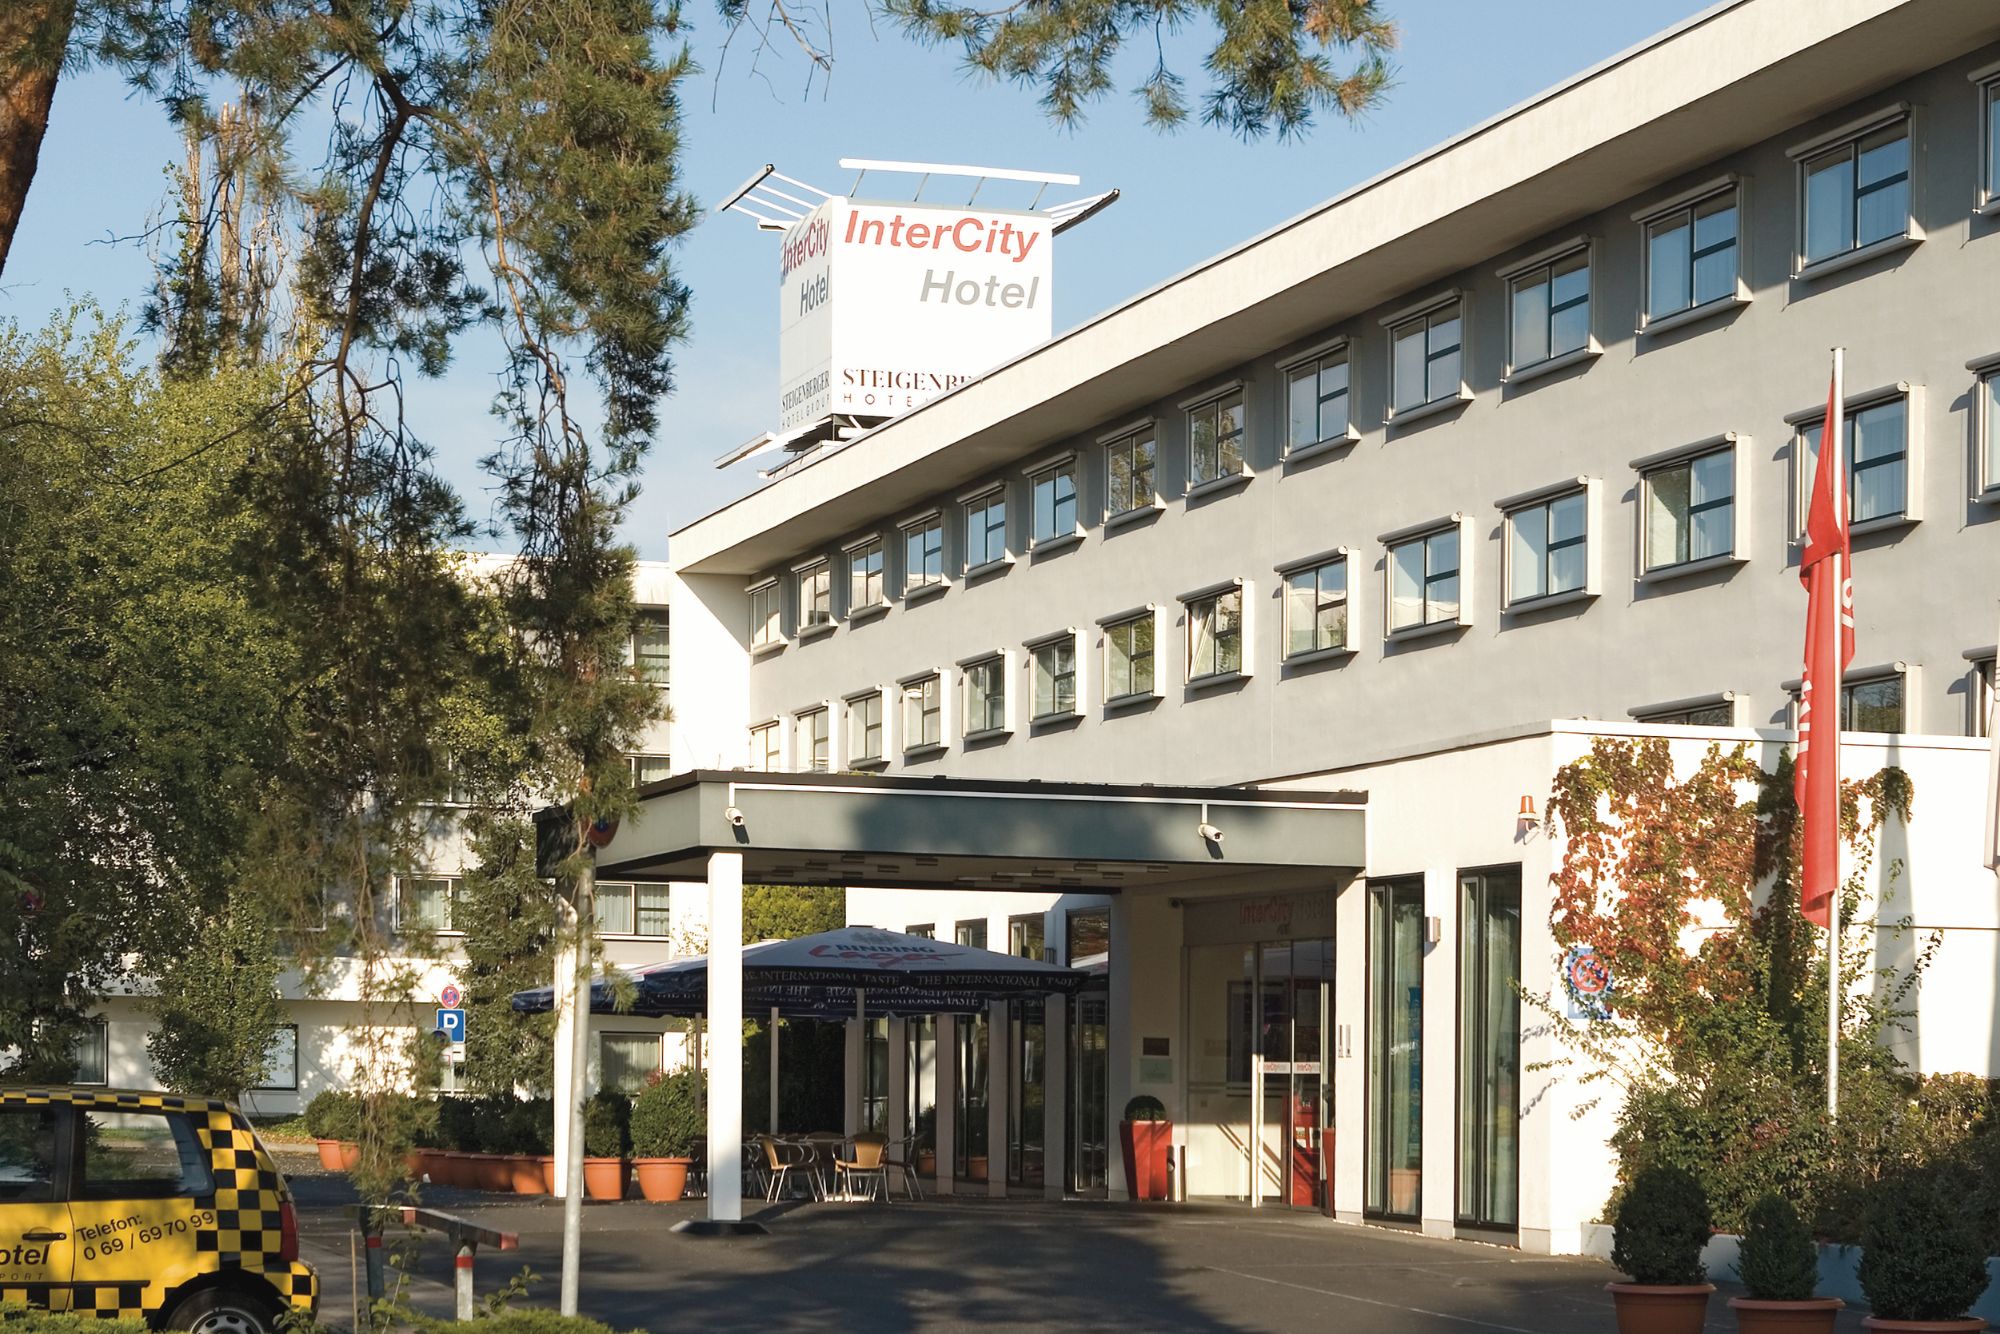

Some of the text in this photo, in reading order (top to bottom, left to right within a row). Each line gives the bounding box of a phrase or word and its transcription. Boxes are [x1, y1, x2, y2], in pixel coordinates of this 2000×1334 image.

[783, 218, 830, 277] InterCity
[845, 210, 1040, 263] InterCity
[800, 265, 830, 317] Hotel
[920, 269, 1040, 309] Hotel
[782, 370, 830, 411] STEIGENBERGER
[916, 975, 942, 986] THE
[945, 975, 1040, 987] INTERNATIONAL
[443, 1013, 459, 1030] P
[76, 1214, 143, 1242] Telefon:
[83, 1246, 96, 1261] 0
[100, 1238, 124, 1256] 69
[190, 1211, 214, 1228] 99
